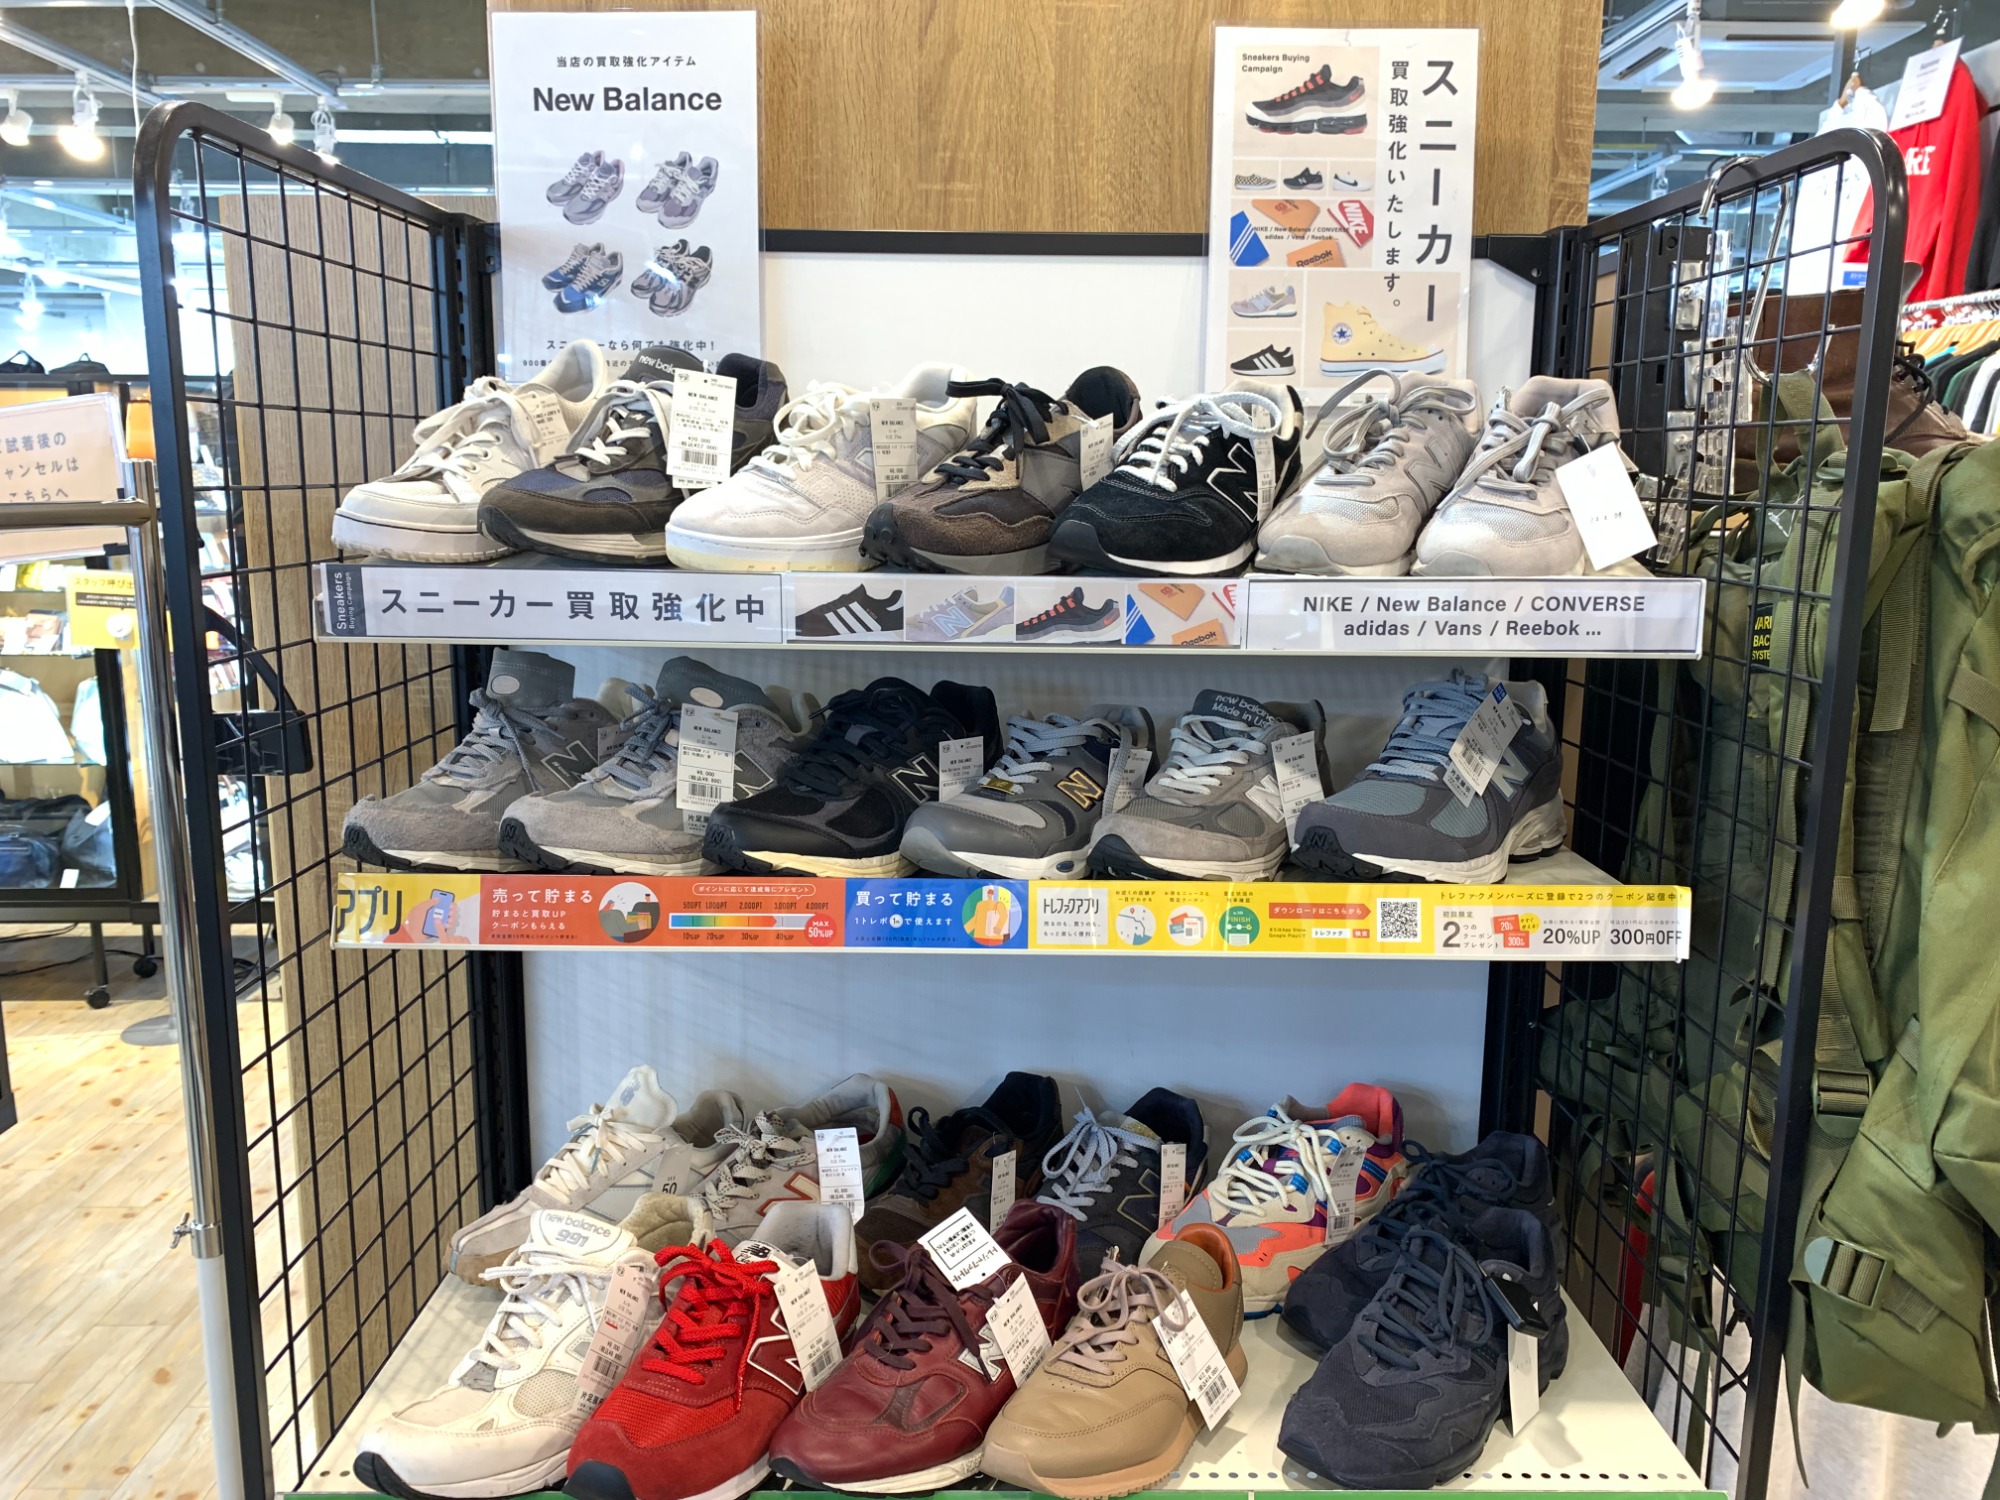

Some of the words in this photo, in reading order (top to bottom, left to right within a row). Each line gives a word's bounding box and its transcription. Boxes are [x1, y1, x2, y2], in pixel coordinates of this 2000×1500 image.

[556, 55, 697, 68] 当店の買取強化アイテム
[1242, 53, 1280, 62] Sneakers
[1282, 53, 1310, 64] Buying
[1242, 64, 1283, 75] Campaign
[533, 88, 594, 111] New
[603, 87, 722, 111] Balance
[1384, 61, 1410, 307] 買取強化いたします。
[1416, 60, 1459, 322] スニーカー
[638, 355, 655, 367] new
[334, 571, 347, 630] Sneakers
[381, 588, 765, 624] スニーカー買取強化中
[1303, 596, 1353, 613] NIKE
[1376, 596, 1420, 613] New
[1427, 596, 1507, 613] Balance
[1530, 596, 1646, 614] CONVERSE
[1344, 620, 1410, 636] adidas
[1435, 620, 1483, 636] Vans
[1753, 634, 1771, 647] BAC
[1752, 649, 1771, 660] SYSTE
[1212, 702, 1240, 717] Made
[1242, 711, 1252, 722] in
[1215, 694, 1239, 705] new
[1238, 698, 1276, 726] balanc
[492, 888, 593, 904] 売って貯まる
[856, 891, 953, 907] 買って貯まる
[337, 885, 402, 935] アプリ
[1273, 906, 1362, 915] ダウンロードはこちらから
[492, 922, 566, 930] クーポンもらえる
[808, 928, 833, 938] 50%UP
[1442, 921, 1461, 948] 2
[1542, 928, 1601, 945] 20%UP
[544, 1212, 564, 1225] new
[564, 1216, 612, 1238] balance
[555, 1229, 590, 1247] 991
